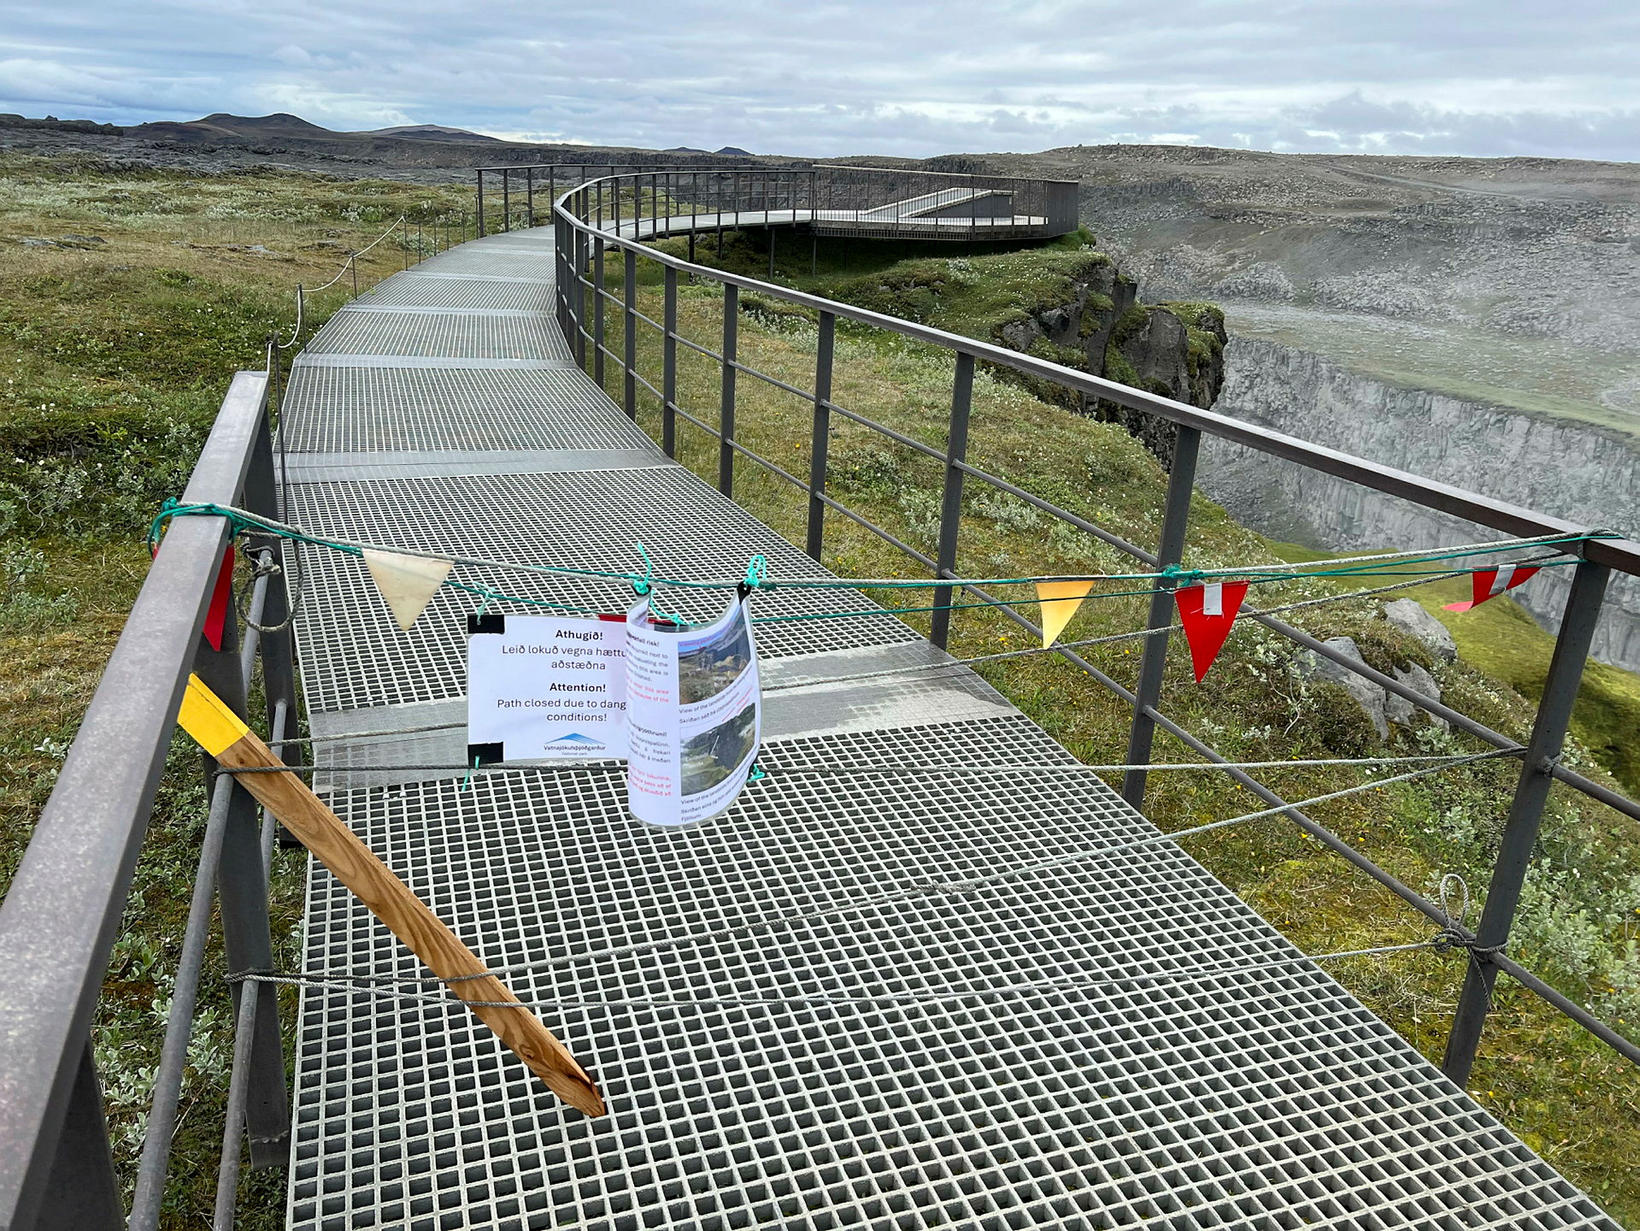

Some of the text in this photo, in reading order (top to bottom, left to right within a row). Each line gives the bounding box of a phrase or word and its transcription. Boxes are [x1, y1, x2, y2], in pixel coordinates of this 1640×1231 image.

[555, 629, 604, 641] Athugið!
[502, 644, 526, 655] Leið
[528, 644, 559, 655] lokuð
[561, 648, 593, 657] vegna
[551, 659, 606, 670] aðstæðna
[549, 682, 606, 693] Attention!
[497, 698, 522, 708] Path
[524, 698, 561, 708] closed
[563, 698, 584, 708] due
[587, 700, 597, 708] to
[546, 712, 607, 722] conditions!
